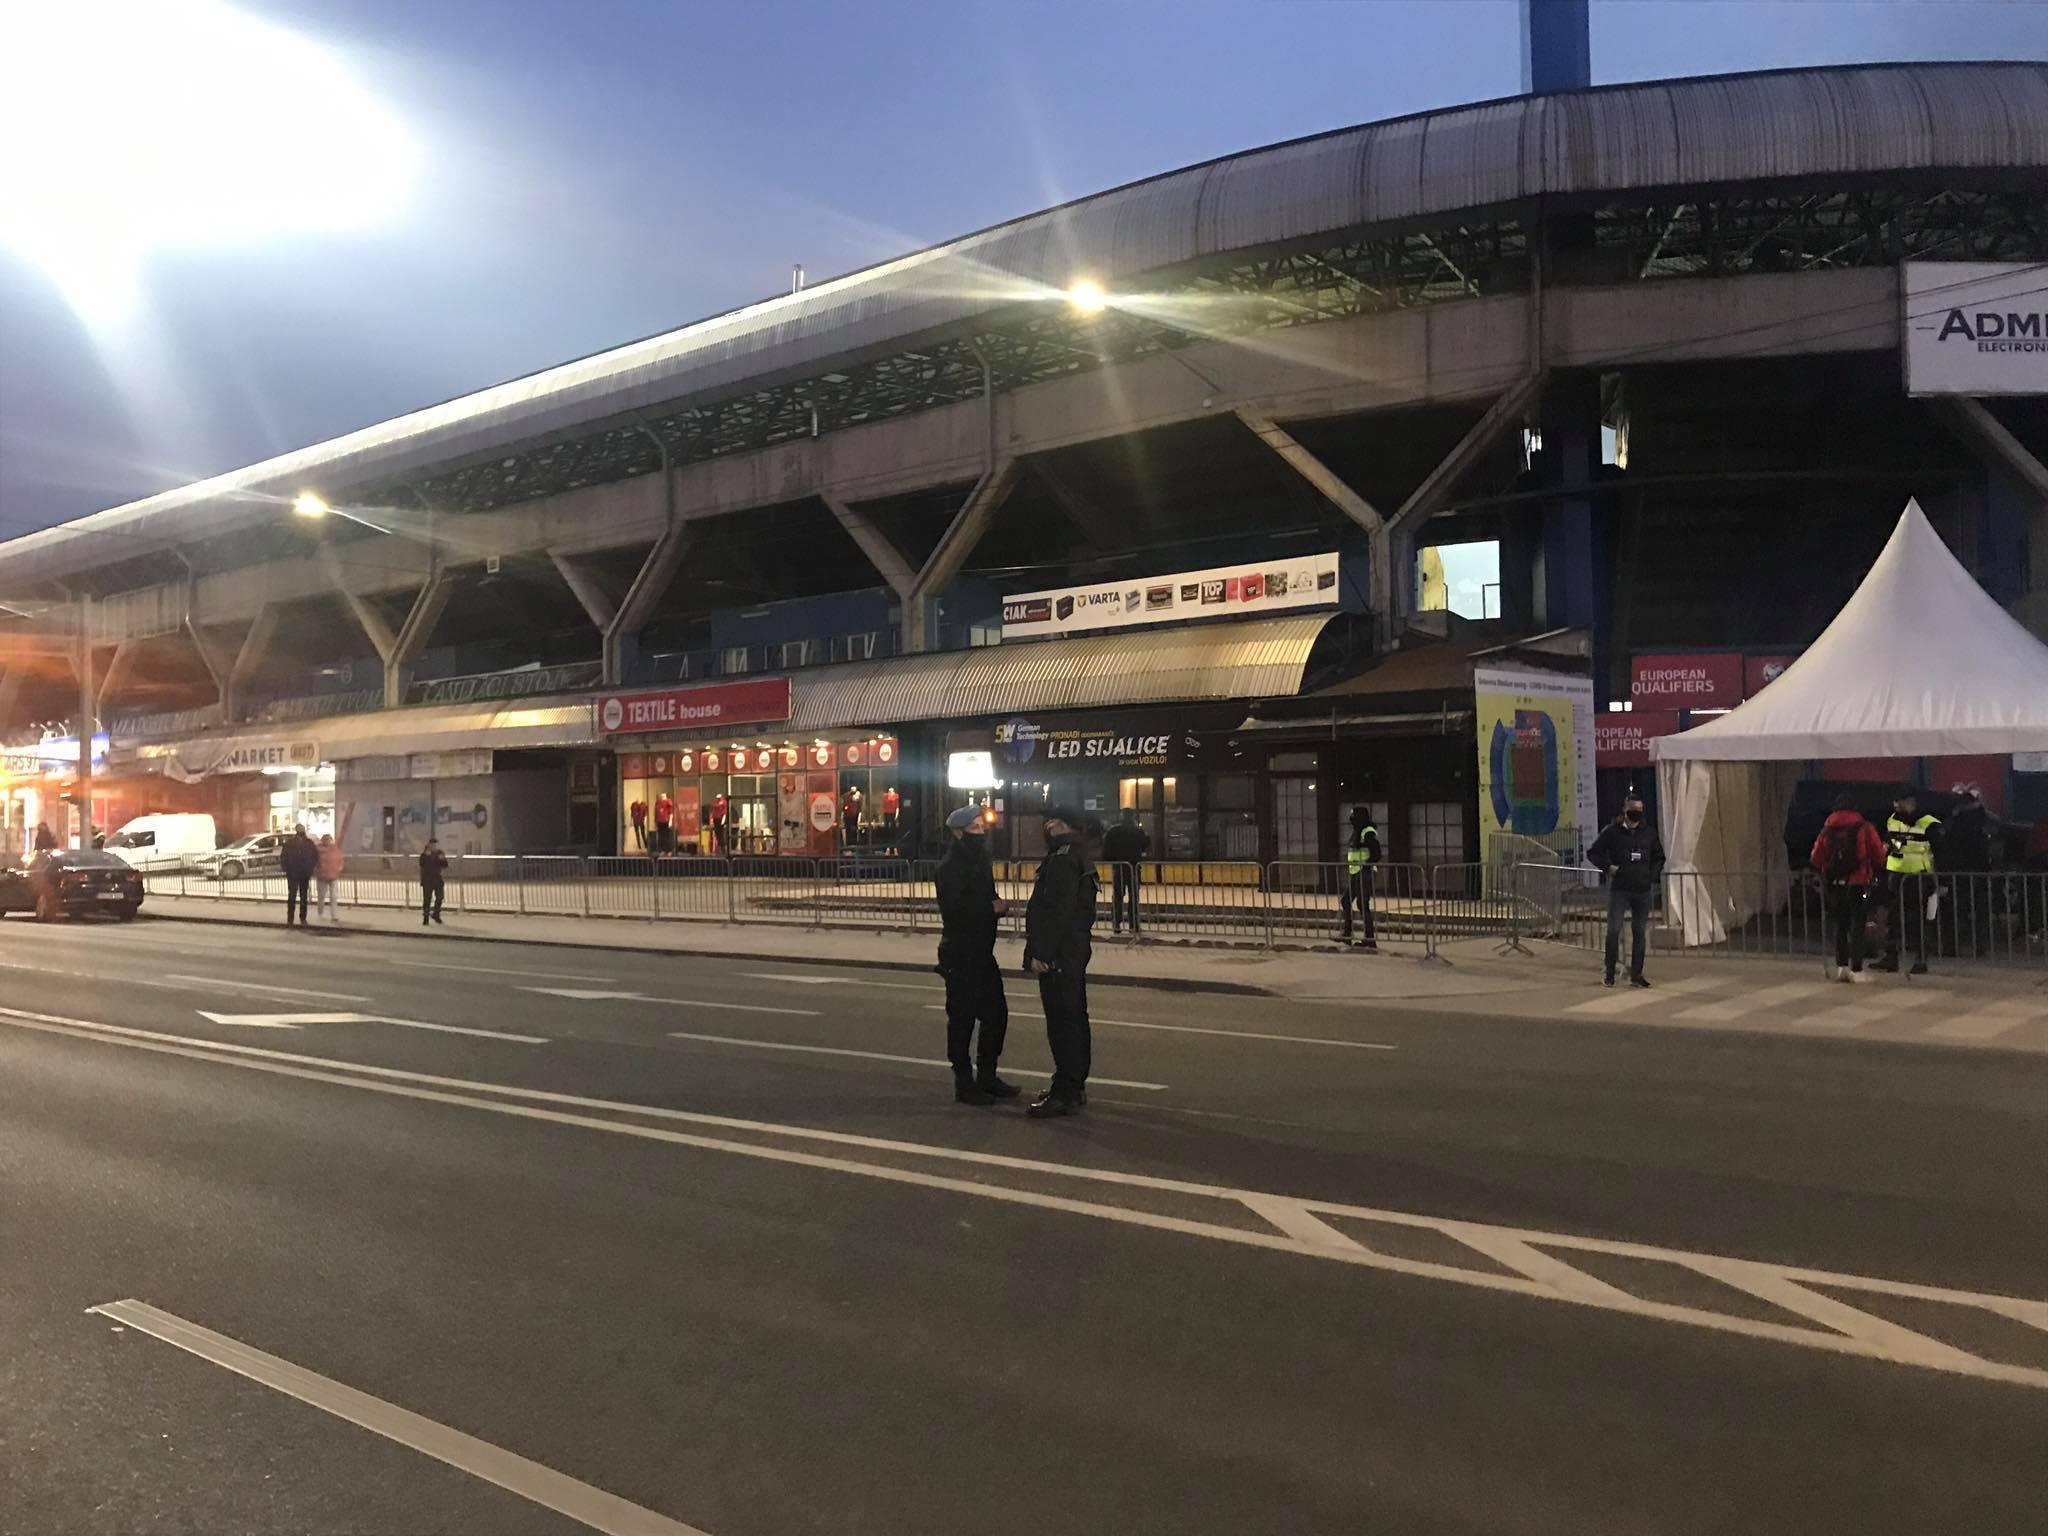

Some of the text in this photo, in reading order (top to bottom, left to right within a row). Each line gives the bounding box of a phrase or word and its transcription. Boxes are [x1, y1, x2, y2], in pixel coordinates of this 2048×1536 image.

[1203, 581, 1223, 597] TOP
[1088, 592, 1120, 605] VARTA
[1003, 605, 1027, 621] CIAK
[1640, 669, 1706, 681] EUROPEAN
[1632, 680, 1714, 695] QUALIFIERS
[628, 699, 676, 723] TEXTILE
[680, 704, 721, 719] house
[1595, 727, 1642, 738] ROPEAN
[1048, 735, 1170, 758] LED SIJALICE
[1594, 738, 1650, 751] LIFIERS
